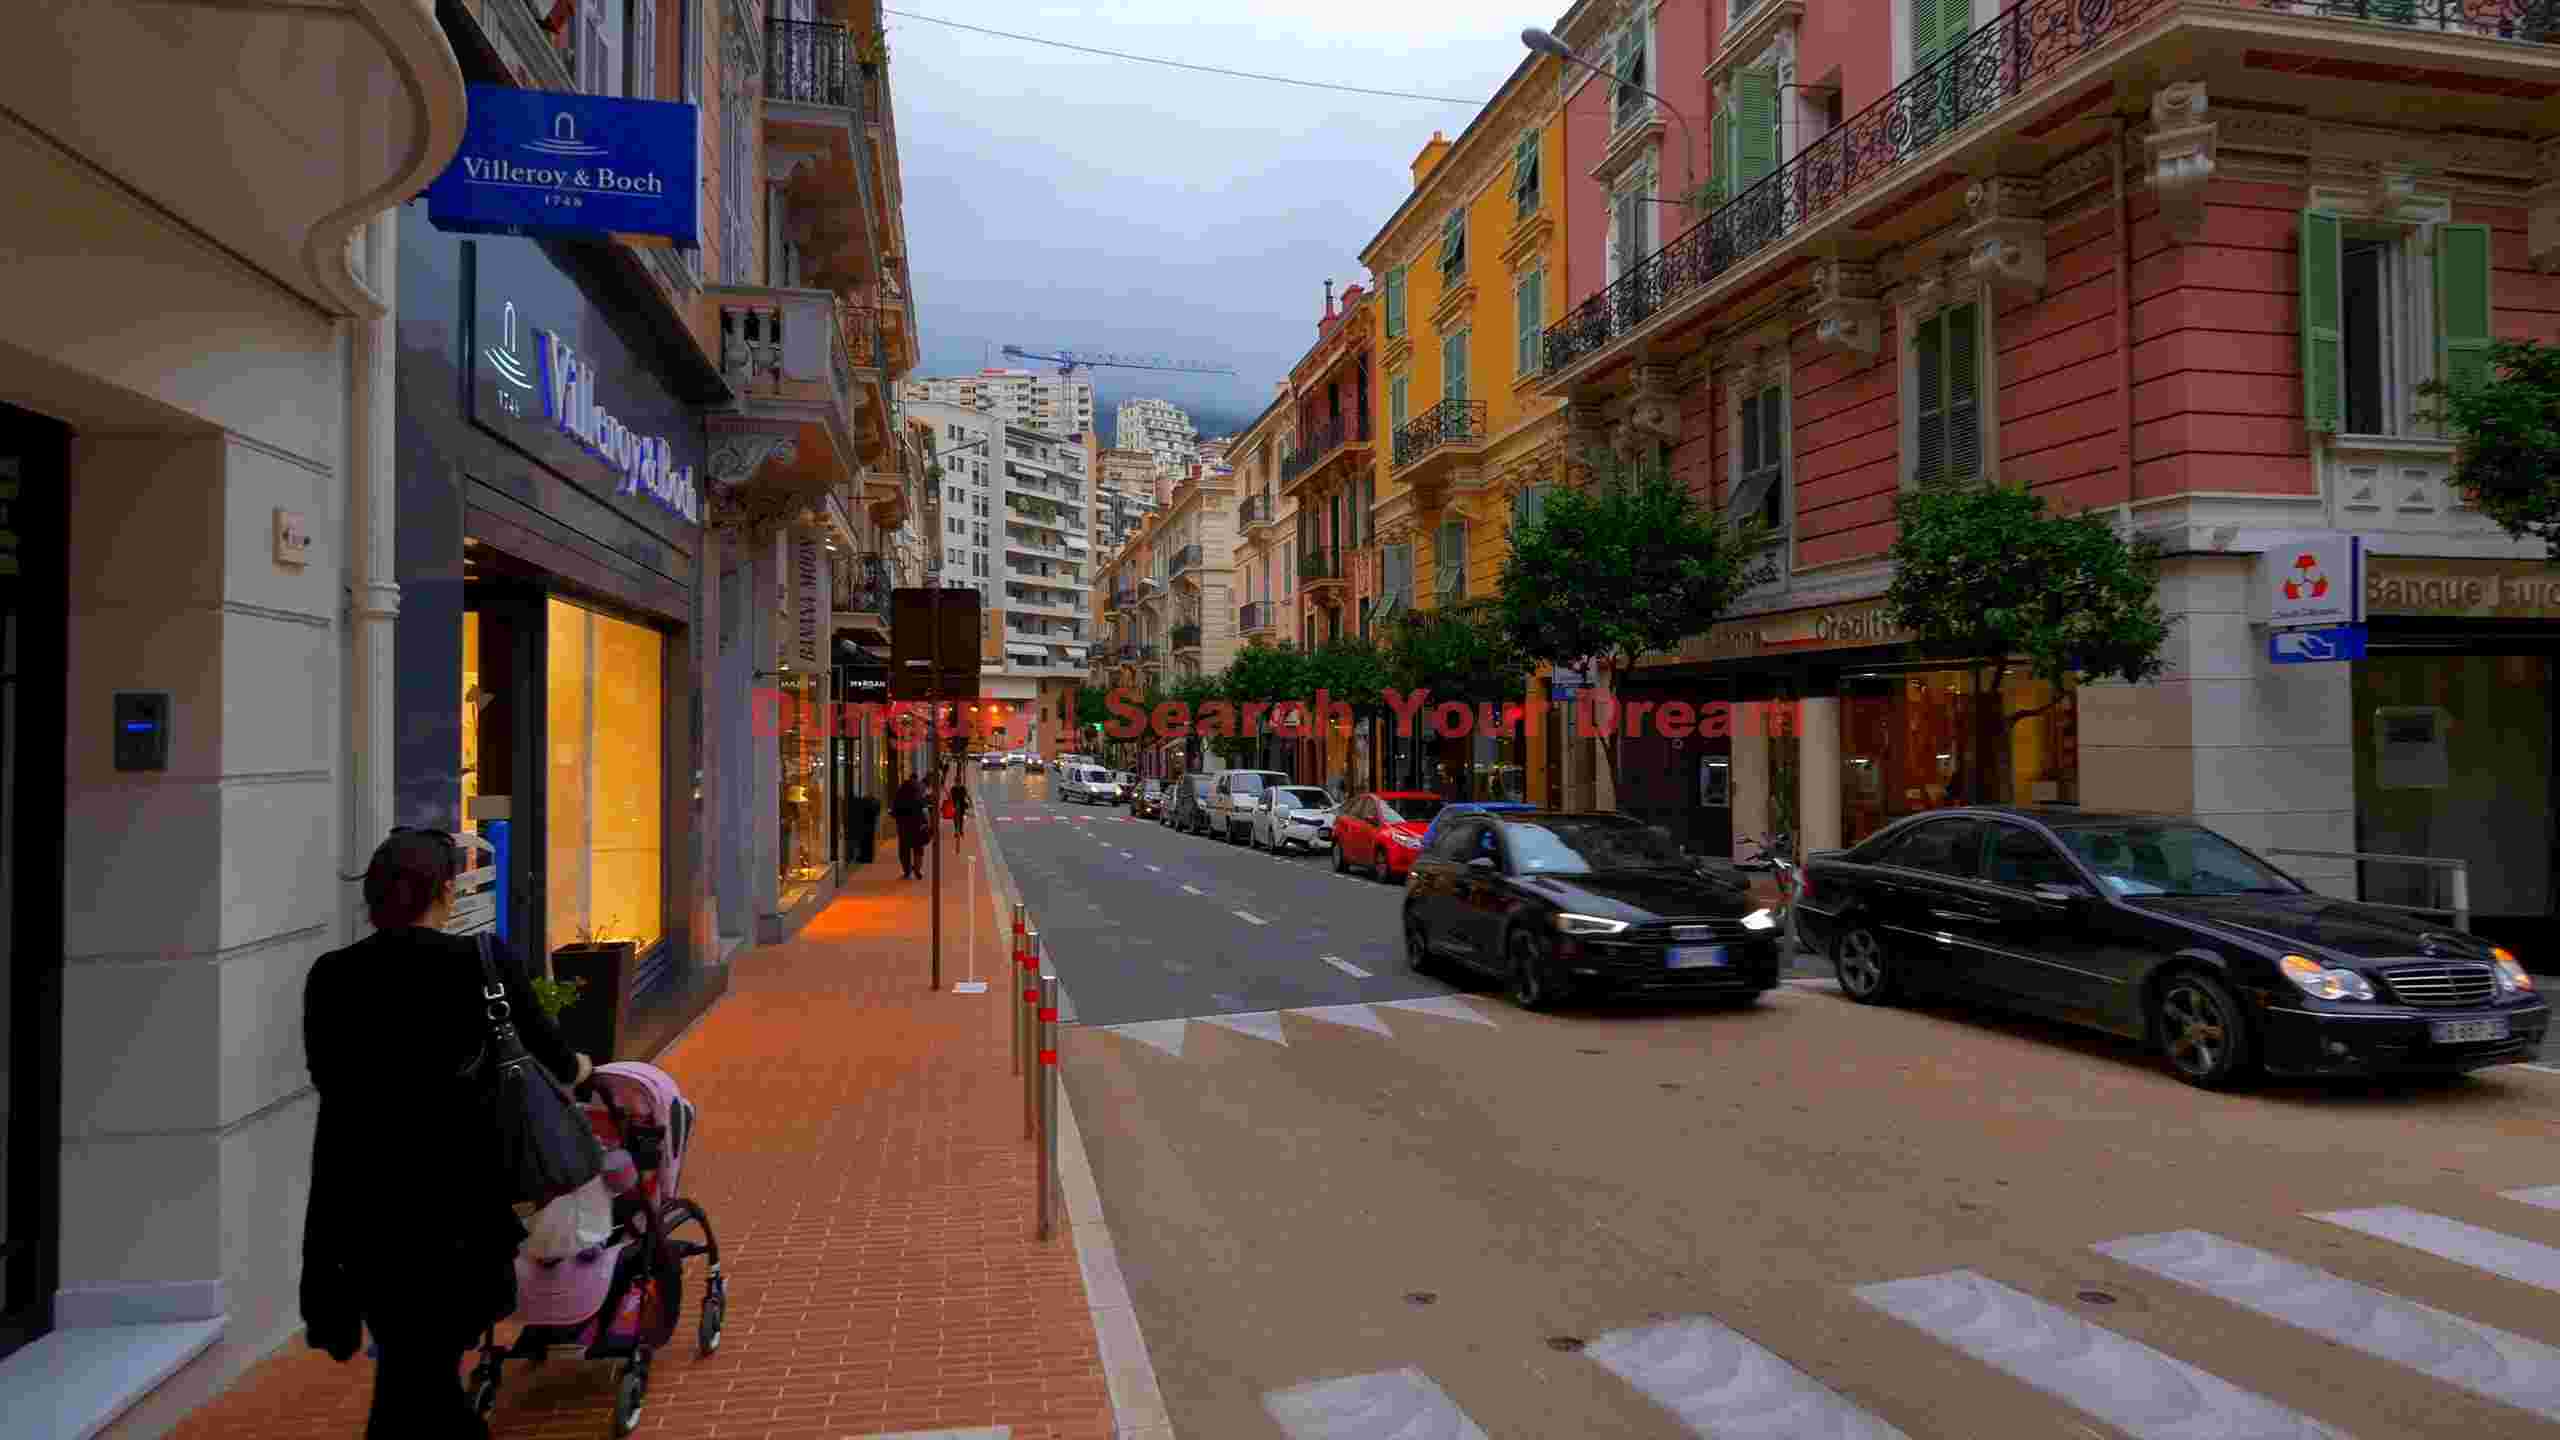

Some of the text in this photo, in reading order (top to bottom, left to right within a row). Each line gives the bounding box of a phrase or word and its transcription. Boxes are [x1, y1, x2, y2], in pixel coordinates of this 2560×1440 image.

[463, 156, 663, 193] Villeroy & Boch
[544, 194, 583, 208] 1748
[2366, 573, 2482, 609] Banque
